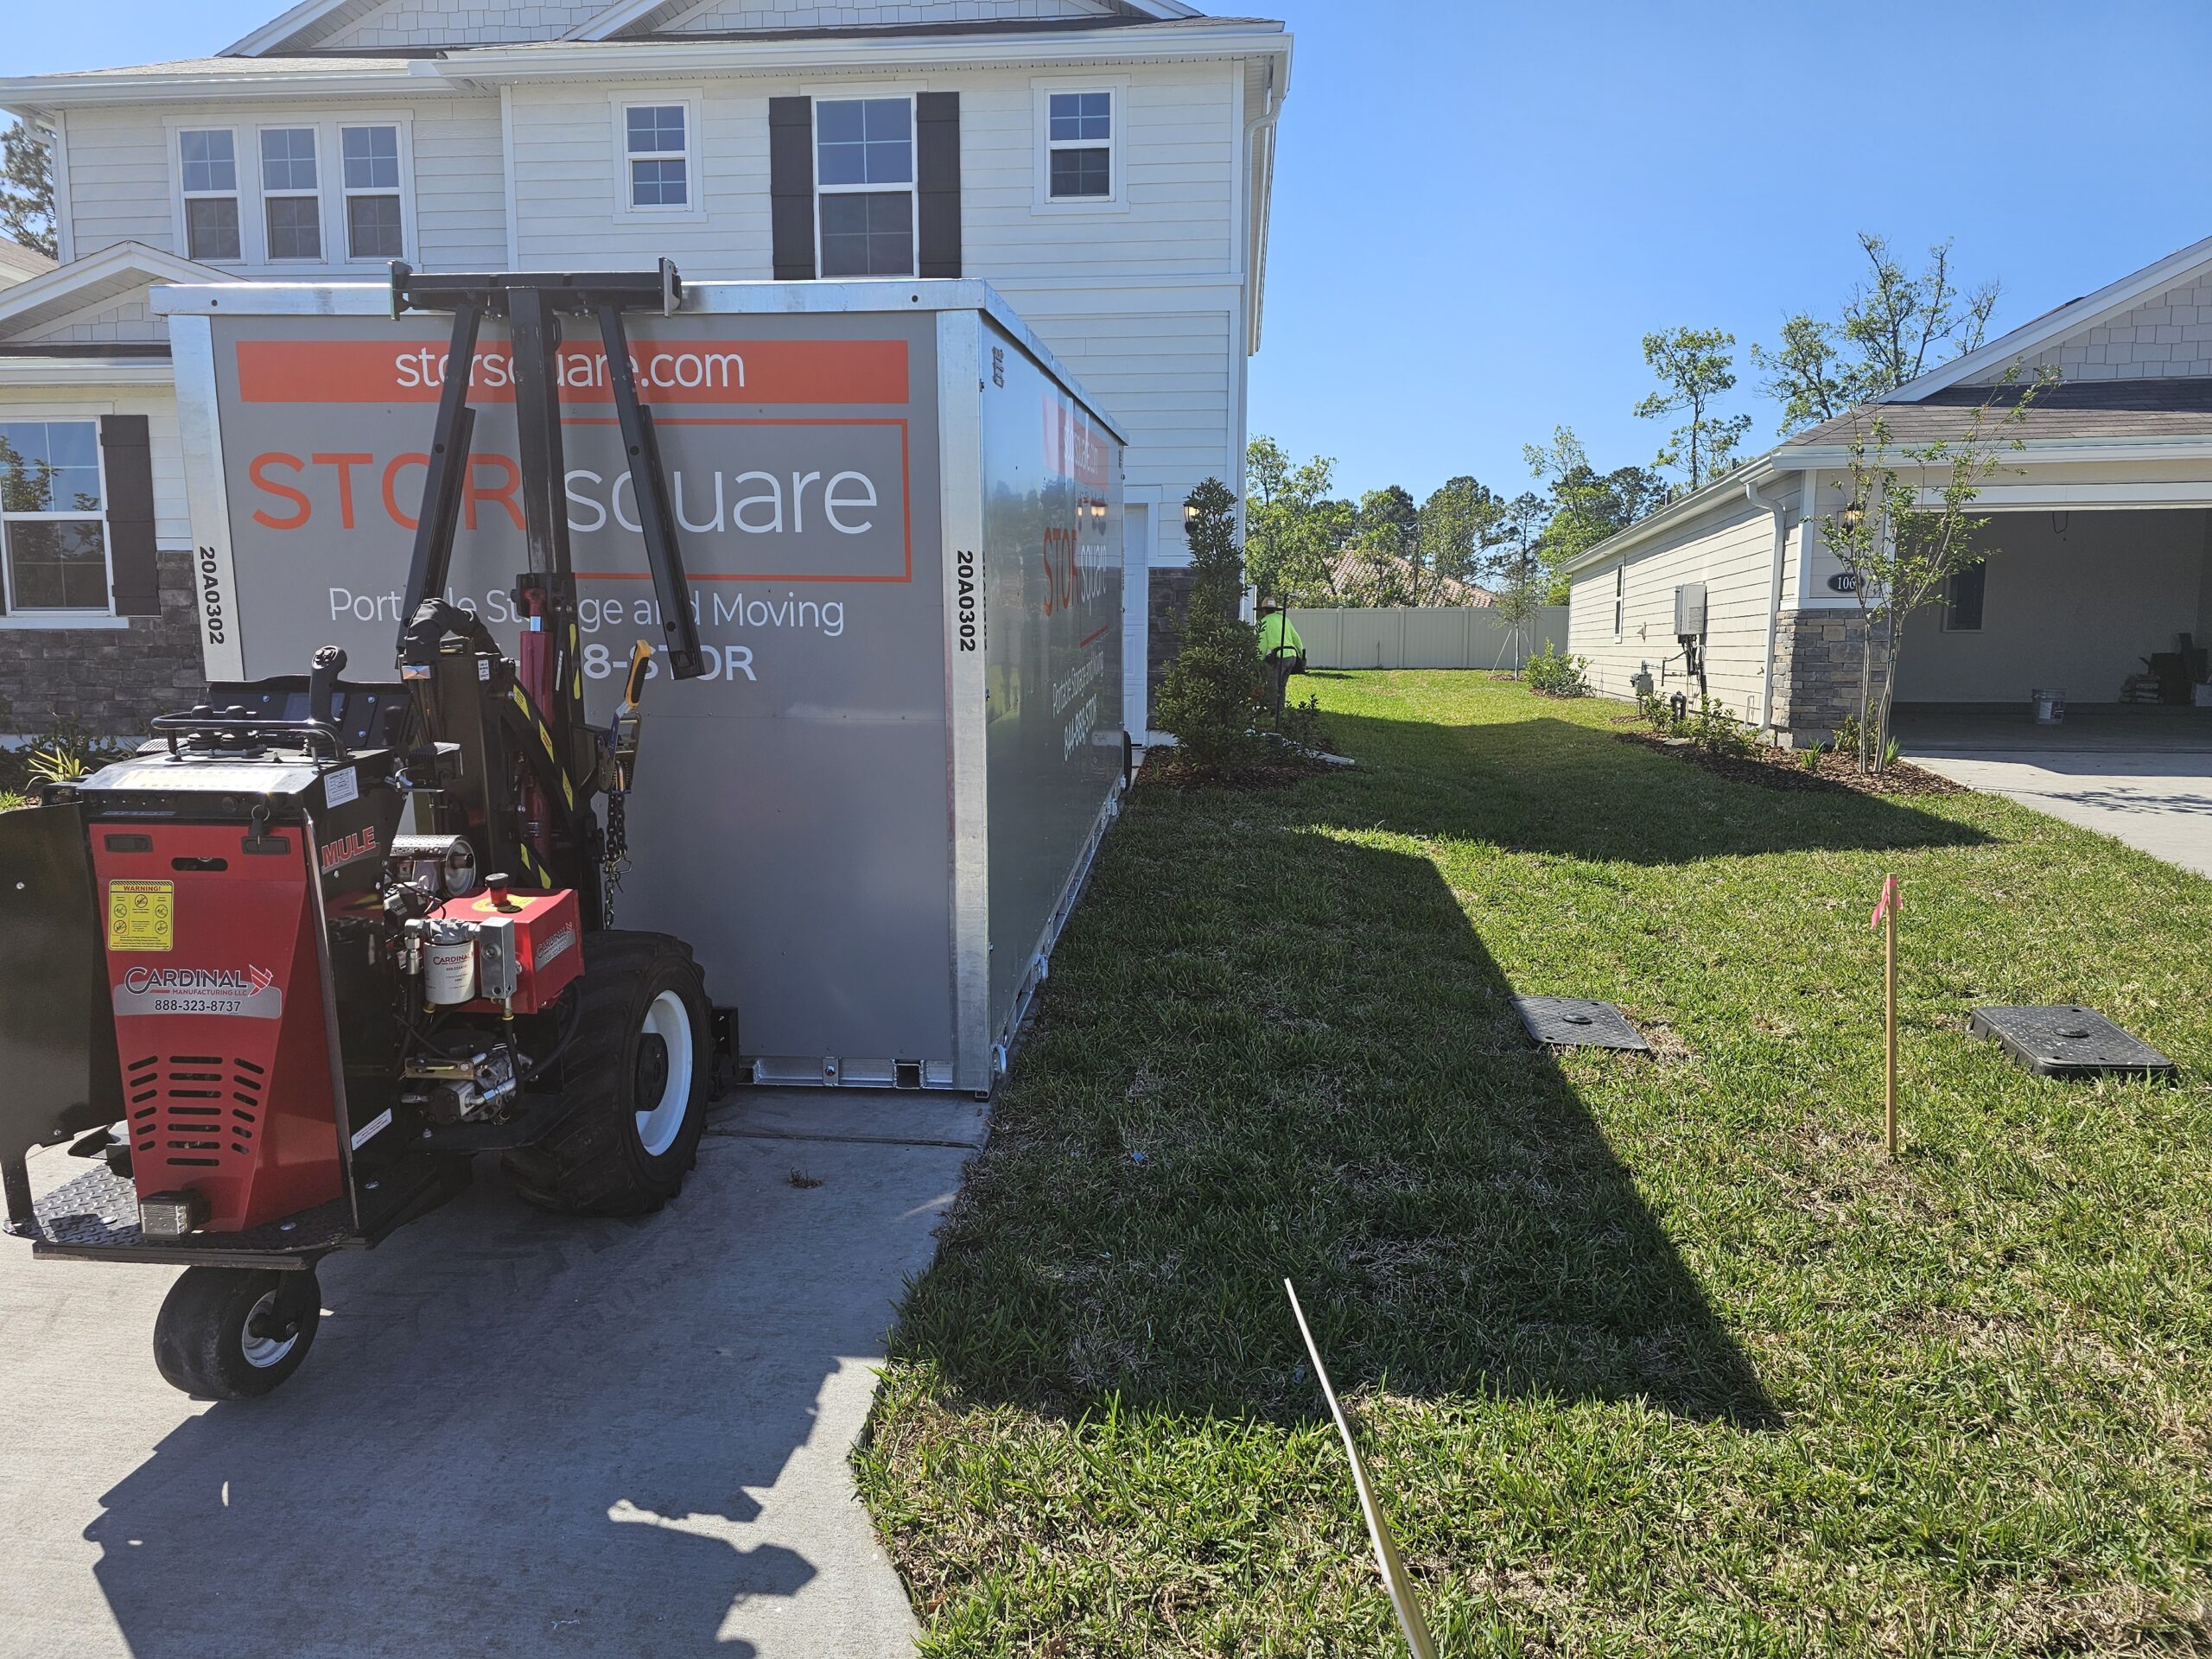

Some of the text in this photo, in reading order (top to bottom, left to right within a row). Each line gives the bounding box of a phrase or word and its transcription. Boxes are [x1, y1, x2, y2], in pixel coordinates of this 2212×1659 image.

[1044, 526, 1079, 617] STOR
[1080, 543, 1107, 616] square
[200, 545, 225, 645] 20A0302
[713, 592, 844, 637] Moving
[957, 550, 976, 652] 20A0302
[321, 825, 376, 868] MULE
[124, 967, 247, 995] CARDINAL
[155, 999, 242, 1012] 888-323-8737
